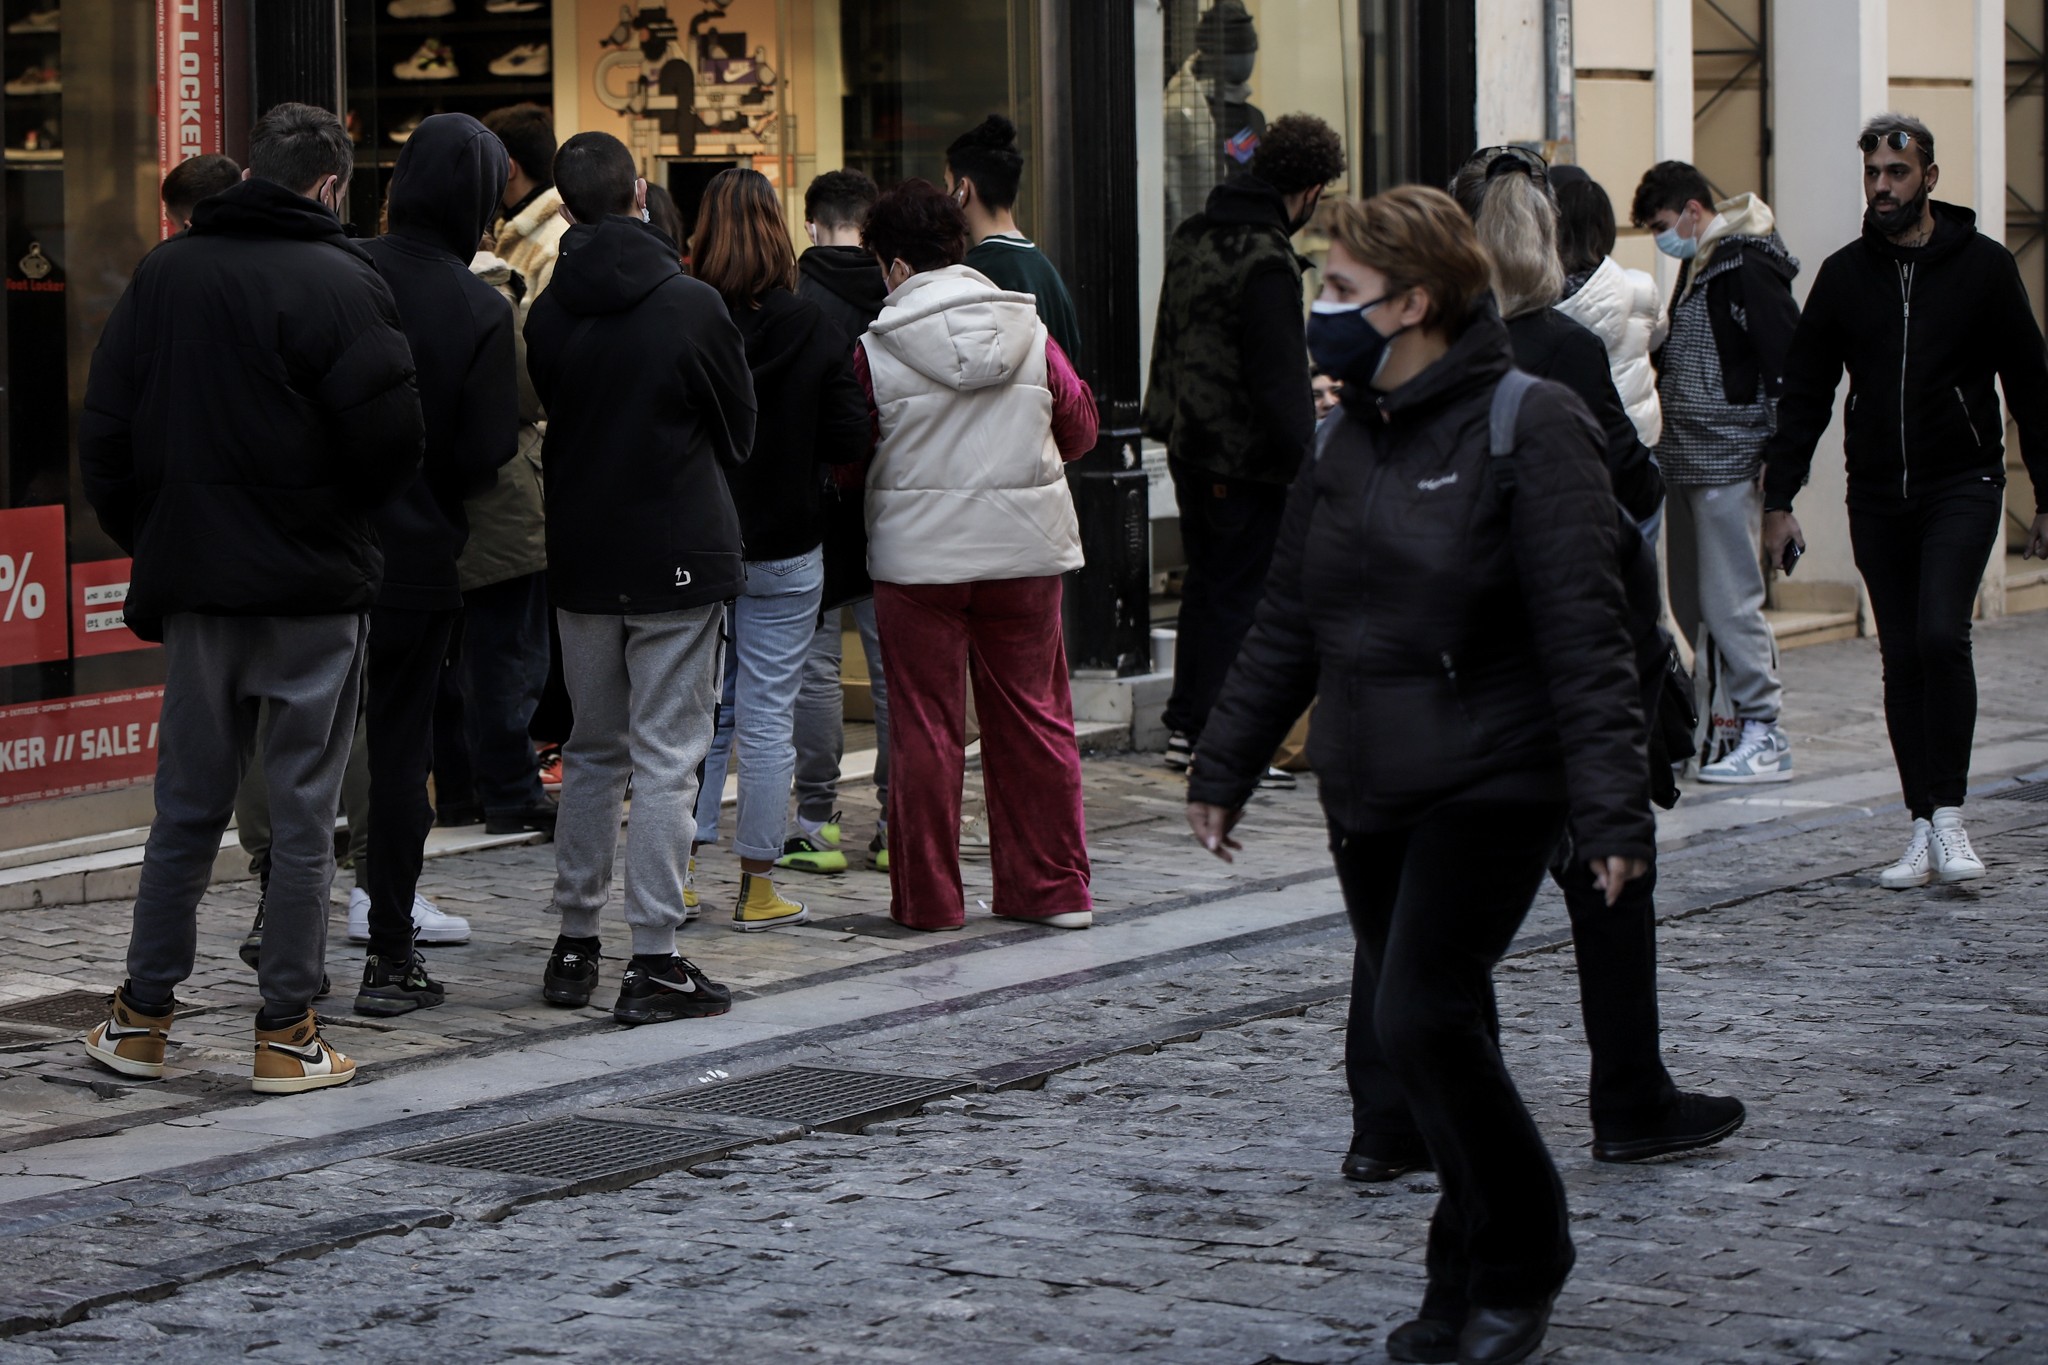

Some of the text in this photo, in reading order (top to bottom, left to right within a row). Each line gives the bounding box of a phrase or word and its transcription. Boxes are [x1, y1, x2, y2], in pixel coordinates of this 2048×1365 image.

[179, 31, 201, 162] LOCKER
[31, 278, 65, 292] Locker
[81, 723, 141, 761] SALE
